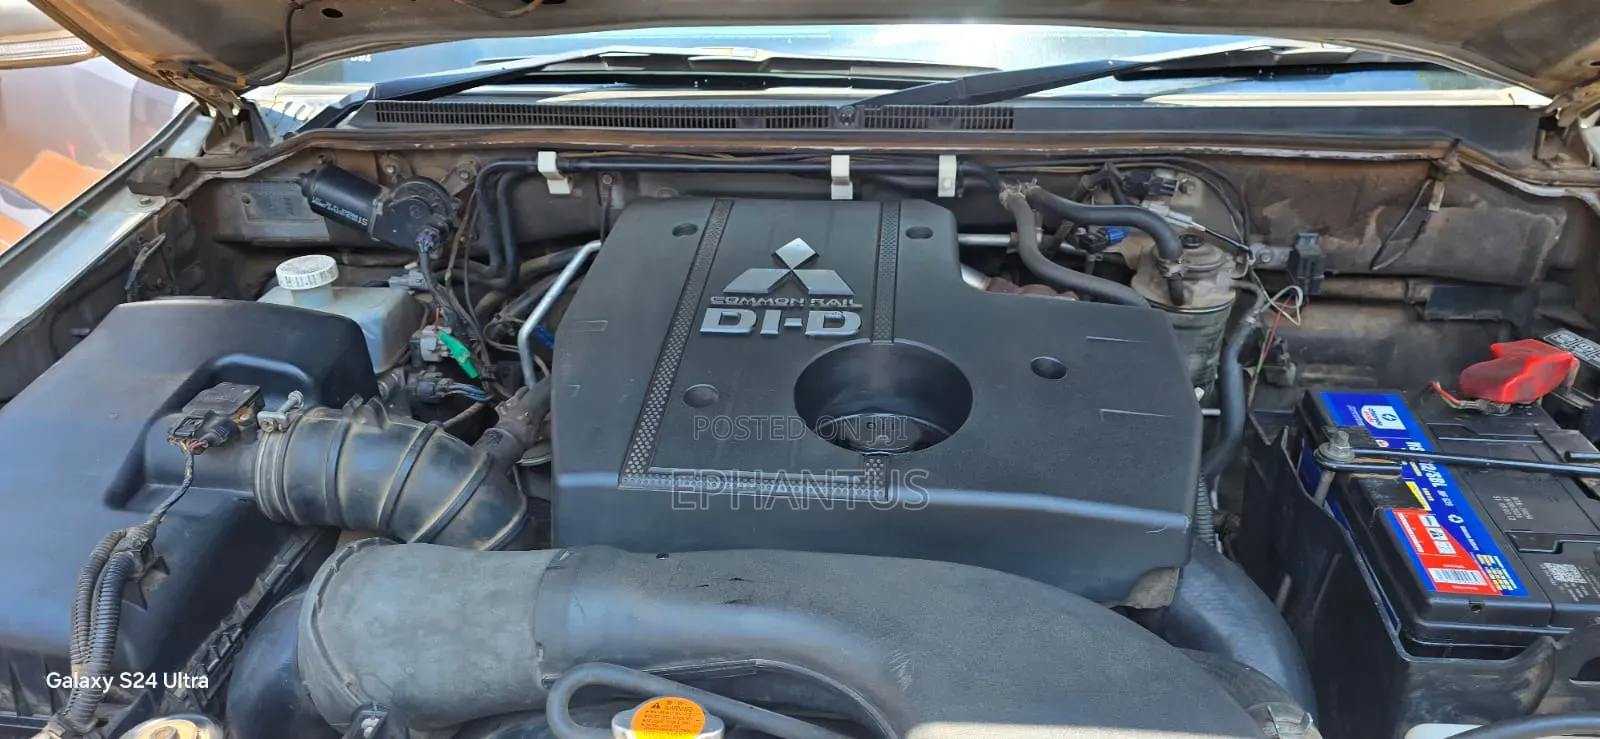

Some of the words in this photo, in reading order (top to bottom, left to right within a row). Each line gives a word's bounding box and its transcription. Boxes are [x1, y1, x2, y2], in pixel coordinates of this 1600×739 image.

[710, 295, 804, 306] COMMON
[810, 297, 863, 307] RAIL
[700, 307, 863, 336] DI-D
